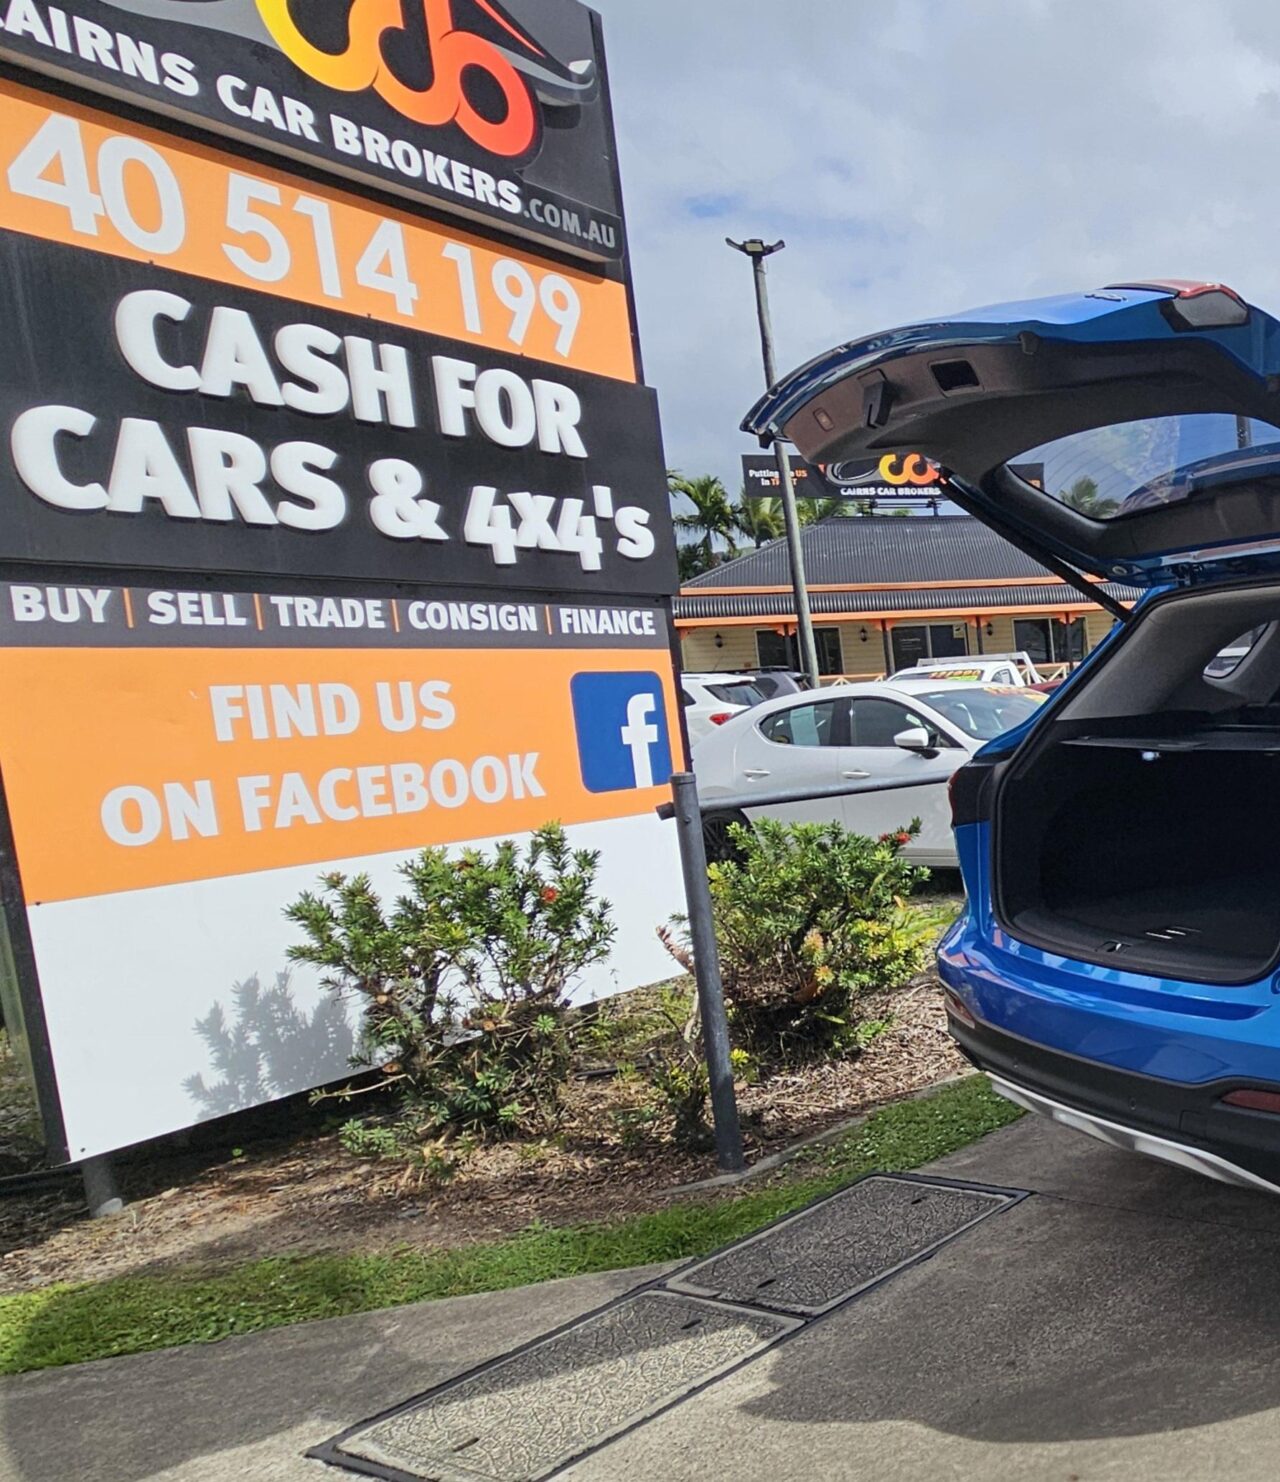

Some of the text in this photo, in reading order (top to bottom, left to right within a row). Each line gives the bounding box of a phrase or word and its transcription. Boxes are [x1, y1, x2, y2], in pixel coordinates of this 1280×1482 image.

[0, 0, 199, 96] AIRNS
[216, 75, 320, 143] CAR
[8, 113, 581, 357] 40 514 199
[115, 289, 587, 458] CASH FOR
[11, 405, 346, 530] CARS
[368, 458, 449, 540] &
[795, 469, 807, 478] US
[841, 487, 941, 496] CAIRNS CAR BROKERS
[12, 586, 656, 636] BUY SELL TRADE CONSIGN FINANCE
[209, 680, 456, 743] FIND US
[100, 752, 546, 847] ON FACEBOOK
